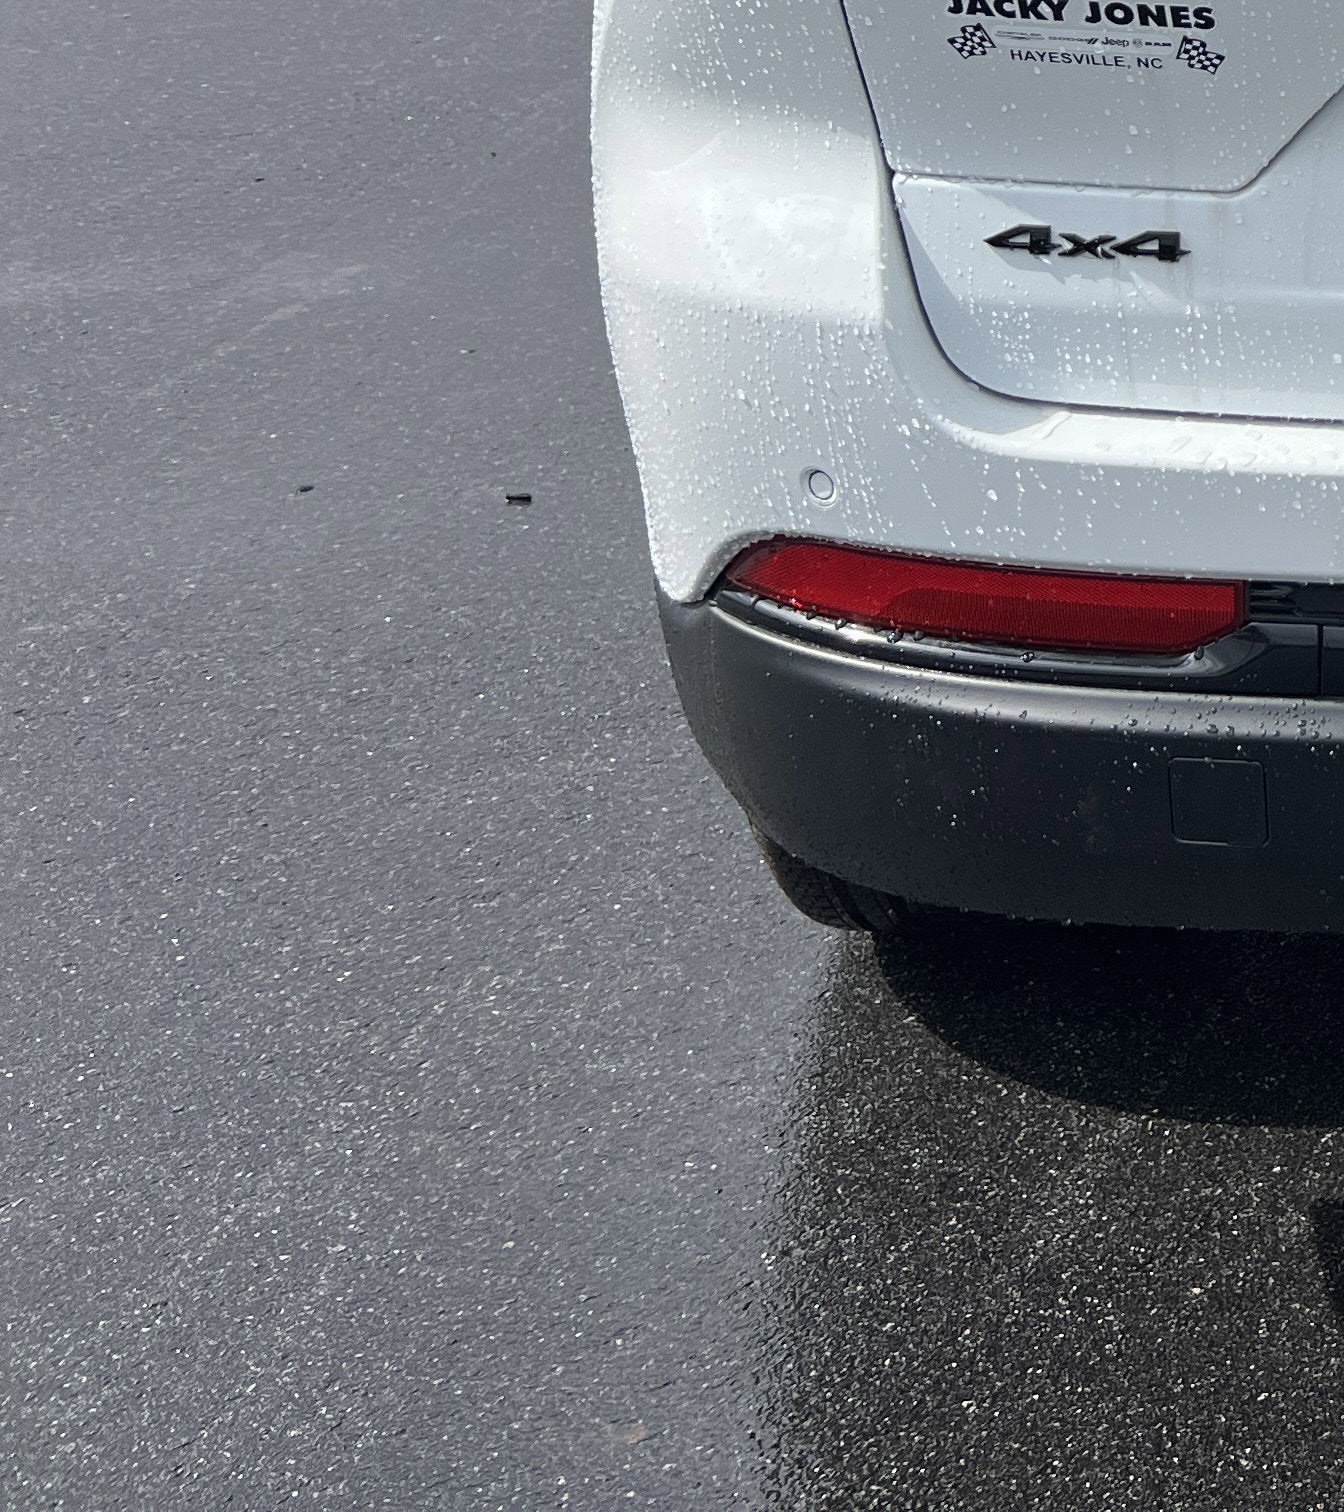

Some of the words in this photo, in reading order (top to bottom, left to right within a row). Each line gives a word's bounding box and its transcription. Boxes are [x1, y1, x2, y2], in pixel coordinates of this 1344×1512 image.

[1085, 0, 1216, 30] JONES
[1101, 37, 1129, 48] Jeep
[1010, 48, 1131, 70] HAYESVILLE,
[1136, 56, 1163, 69] NC
[983, 224, 1191, 262] 4x4
